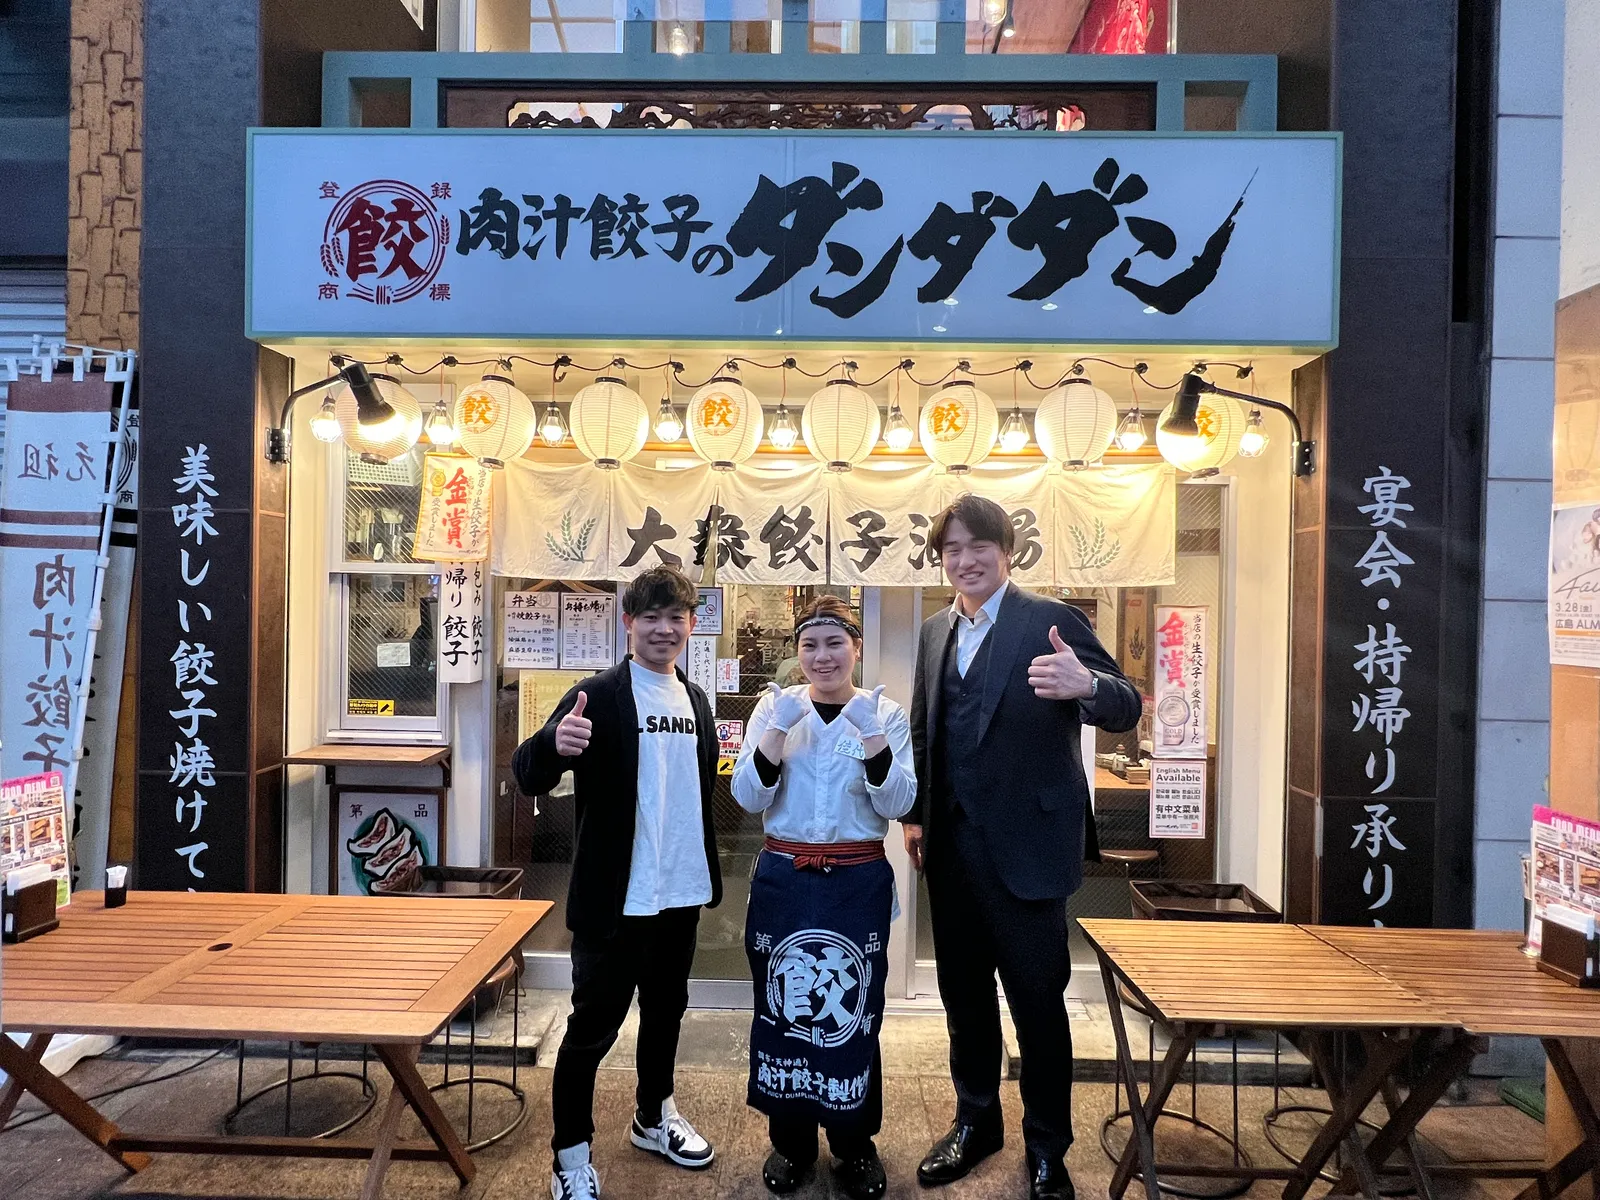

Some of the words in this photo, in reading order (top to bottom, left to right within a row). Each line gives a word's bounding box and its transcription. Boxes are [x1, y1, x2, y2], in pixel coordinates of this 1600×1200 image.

[319, 181, 340, 200] 登
[430, 182, 452, 200] 録
[335, 197, 429, 282] 餃
[318, 283, 339, 301] 商
[429, 283, 451, 301] 標
[462, 396, 493, 426] 餃
[701, 398, 734, 428] 餃
[930, 403, 964, 434] 餃
[442, 467, 468, 548] 金賞
[442, 561, 469, 667] 帰り餃子
[471, 561, 484, 666] 包み餃子
[512, 594, 537, 608] 弁当
[1555, 619, 1573, 629] 広島
[1156, 611, 1186, 688] 金賞
[168, 443, 220, 893] 美味しい餃子焼けて
[1350, 465, 1415, 928] 宴会・持帰り承り
[646, 715, 695, 734] SAND
[1156, 774, 1200, 782] Available
[350, 804, 363, 819] 第
[414, 804, 428, 817] 品
[1156, 805, 1200, 813] 有中文菜单
[754, 931, 773, 953] 第
[865, 932, 880, 954] 品
[773, 945, 858, 1029] 餃
